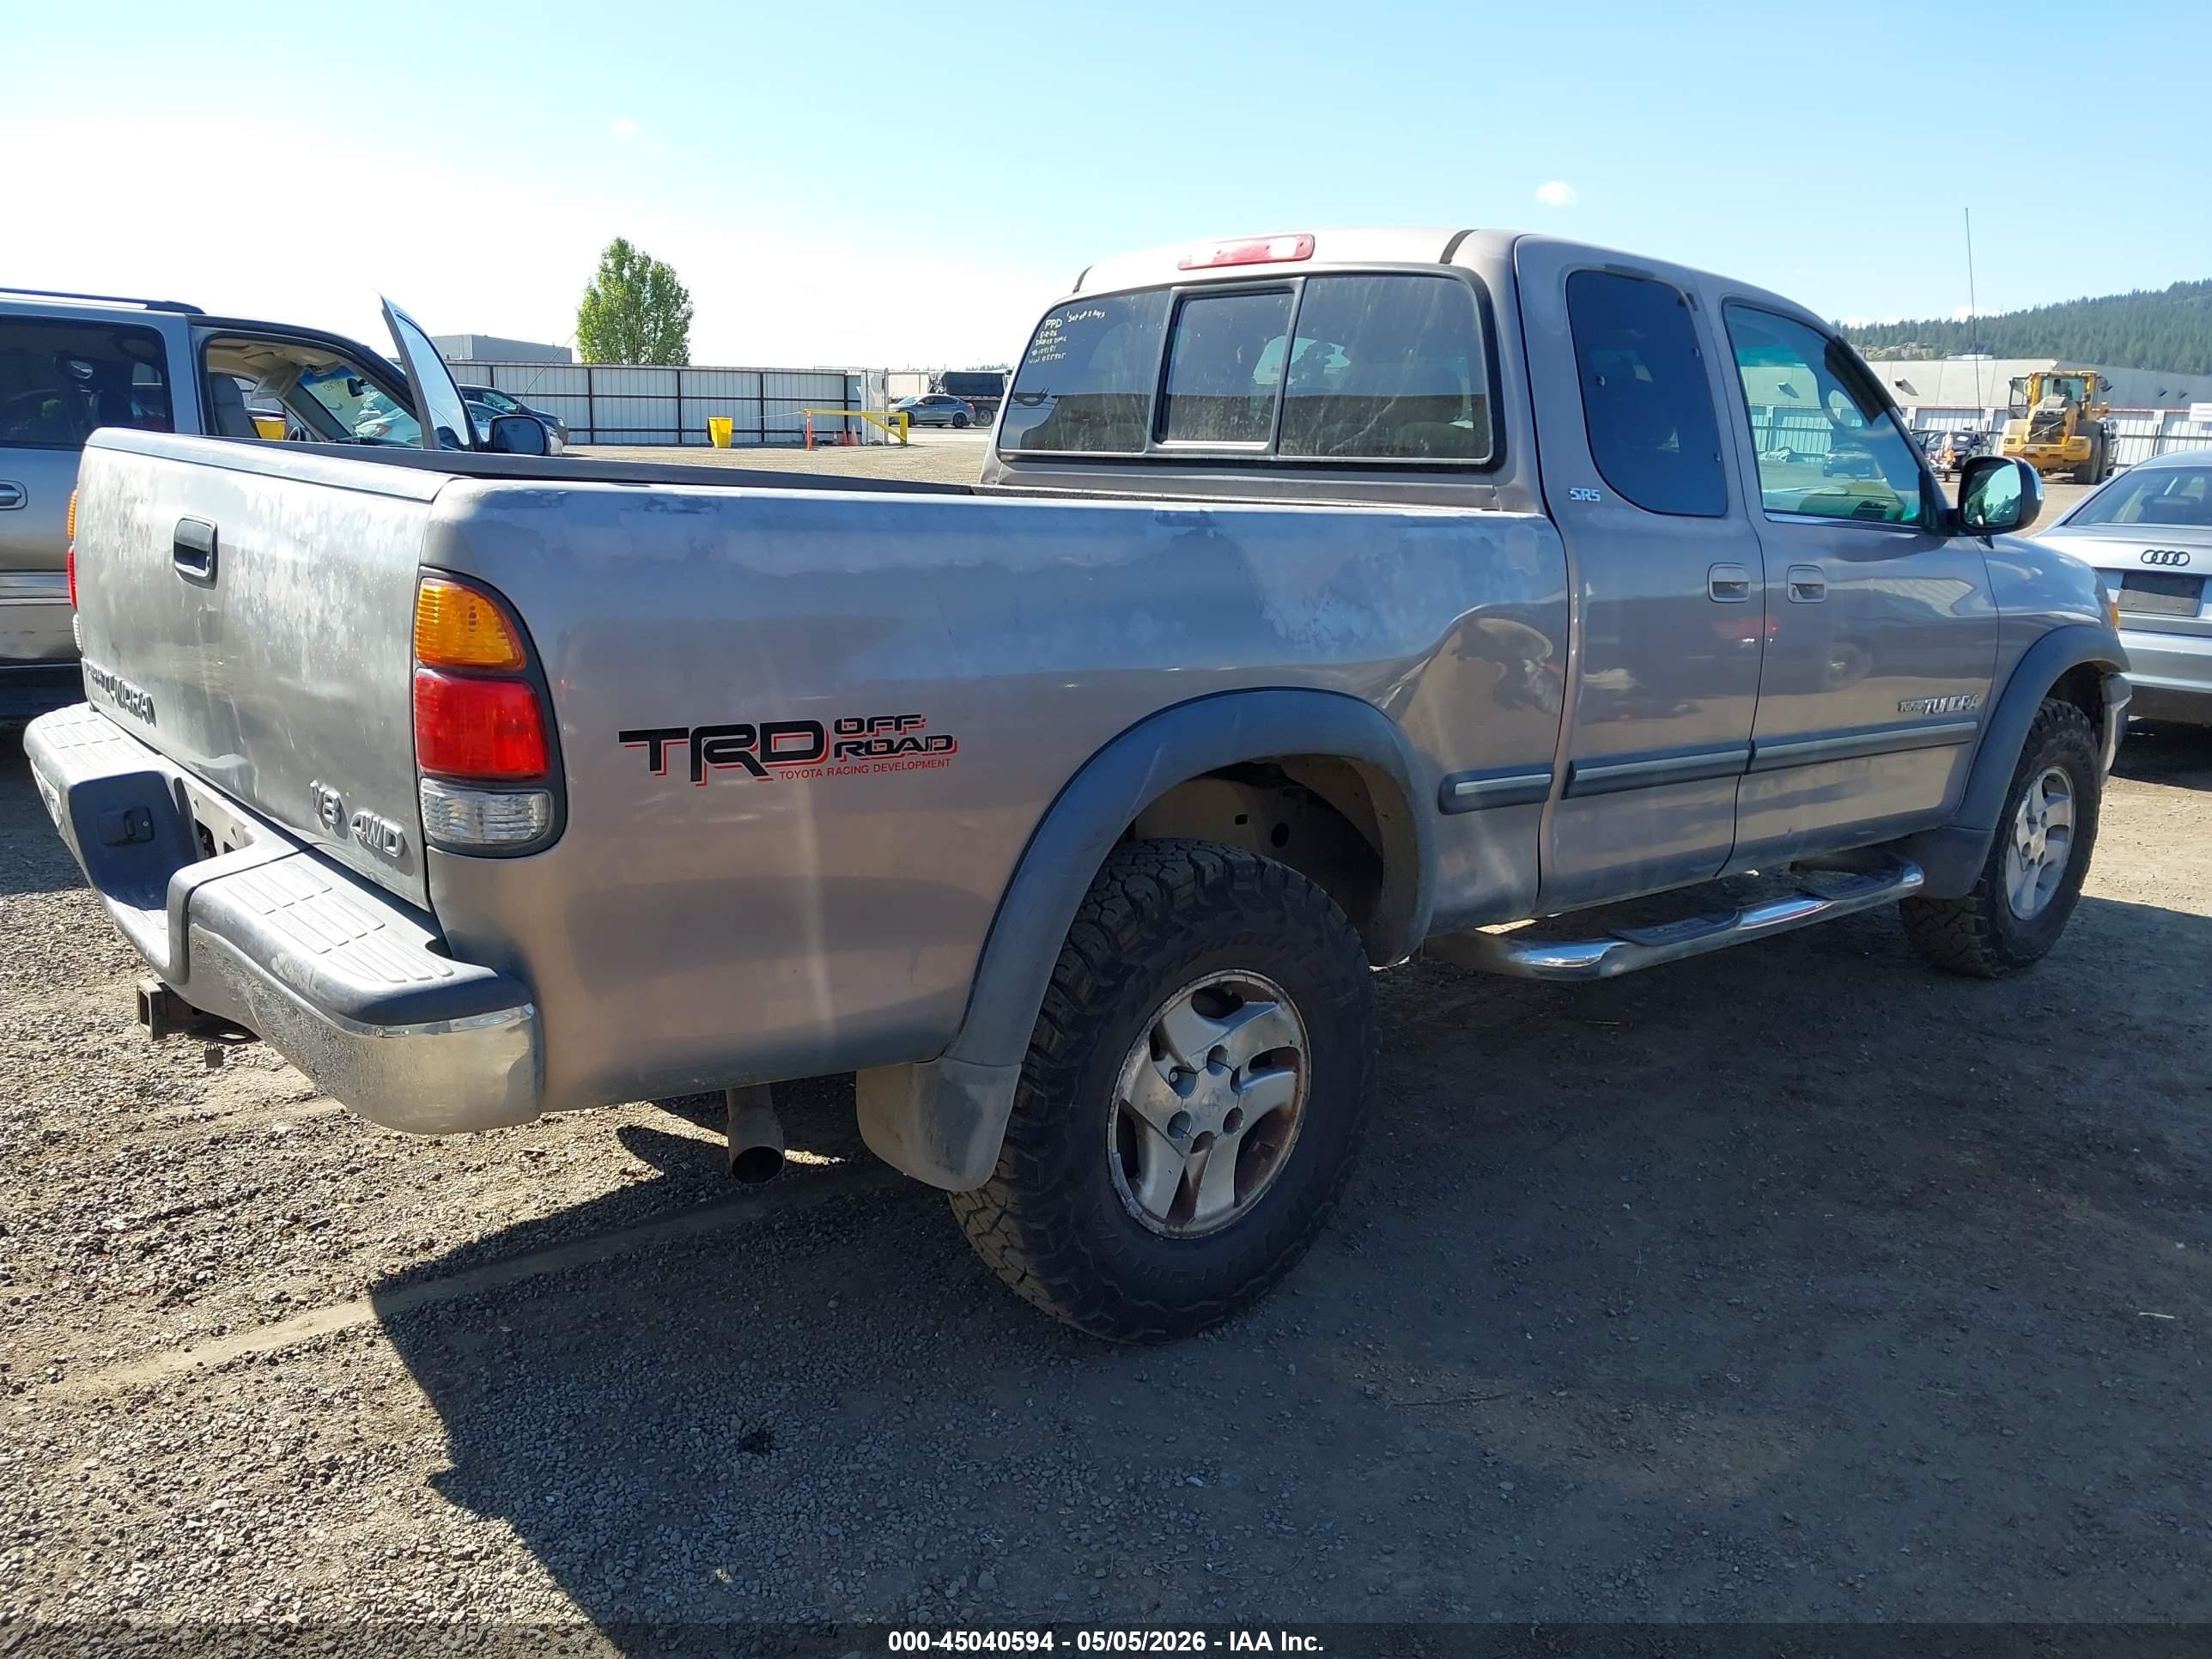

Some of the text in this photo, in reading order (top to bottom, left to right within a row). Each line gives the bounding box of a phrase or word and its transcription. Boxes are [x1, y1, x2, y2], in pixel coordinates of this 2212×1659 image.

[1044, 319, 1063, 329] PPD
[1569, 488, 1601, 501] SR5
[103, 673, 156, 728] TUNDRA
[1923, 694, 1979, 714] TUNDRA
[834, 714, 926, 739] OFF
[619, 720, 830, 787] TRD
[834, 734, 958, 763] ROAD
[780, 758, 952, 781] TOYOTA RACING DEVELOPMENT
[310, 780, 405, 858] V8 4WD
